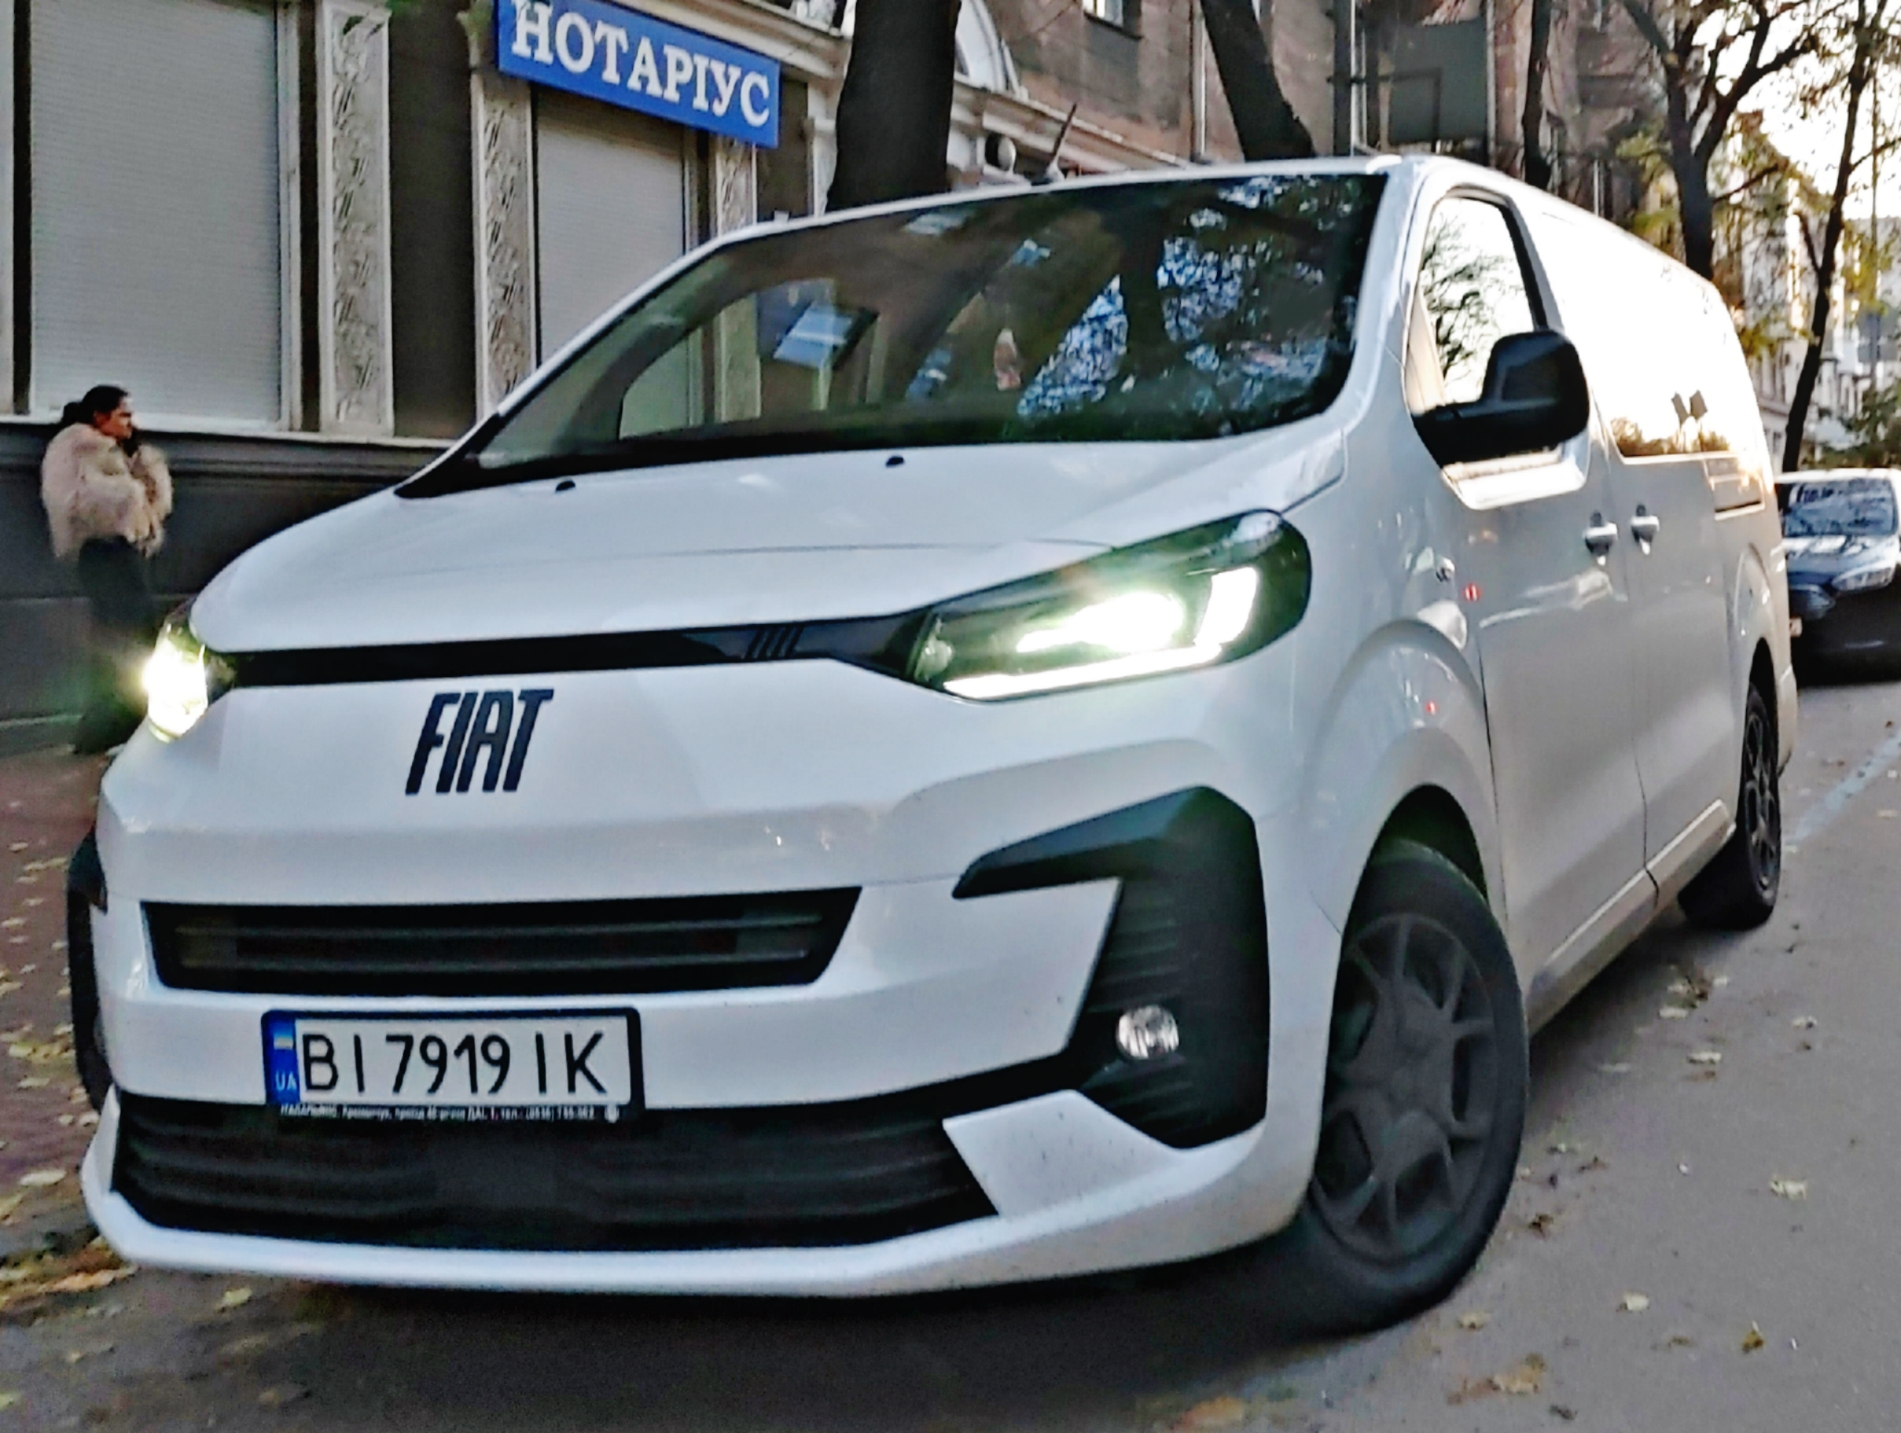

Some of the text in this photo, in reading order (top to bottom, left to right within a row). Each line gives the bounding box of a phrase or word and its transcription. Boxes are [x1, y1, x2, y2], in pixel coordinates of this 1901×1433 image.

[511, 0, 770, 127] НОТАРІУС
[404, 688, 555, 796] FIAT
[274, 1071, 298, 1093] UA
[302, 1031, 608, 1095] BI 7919 IK
